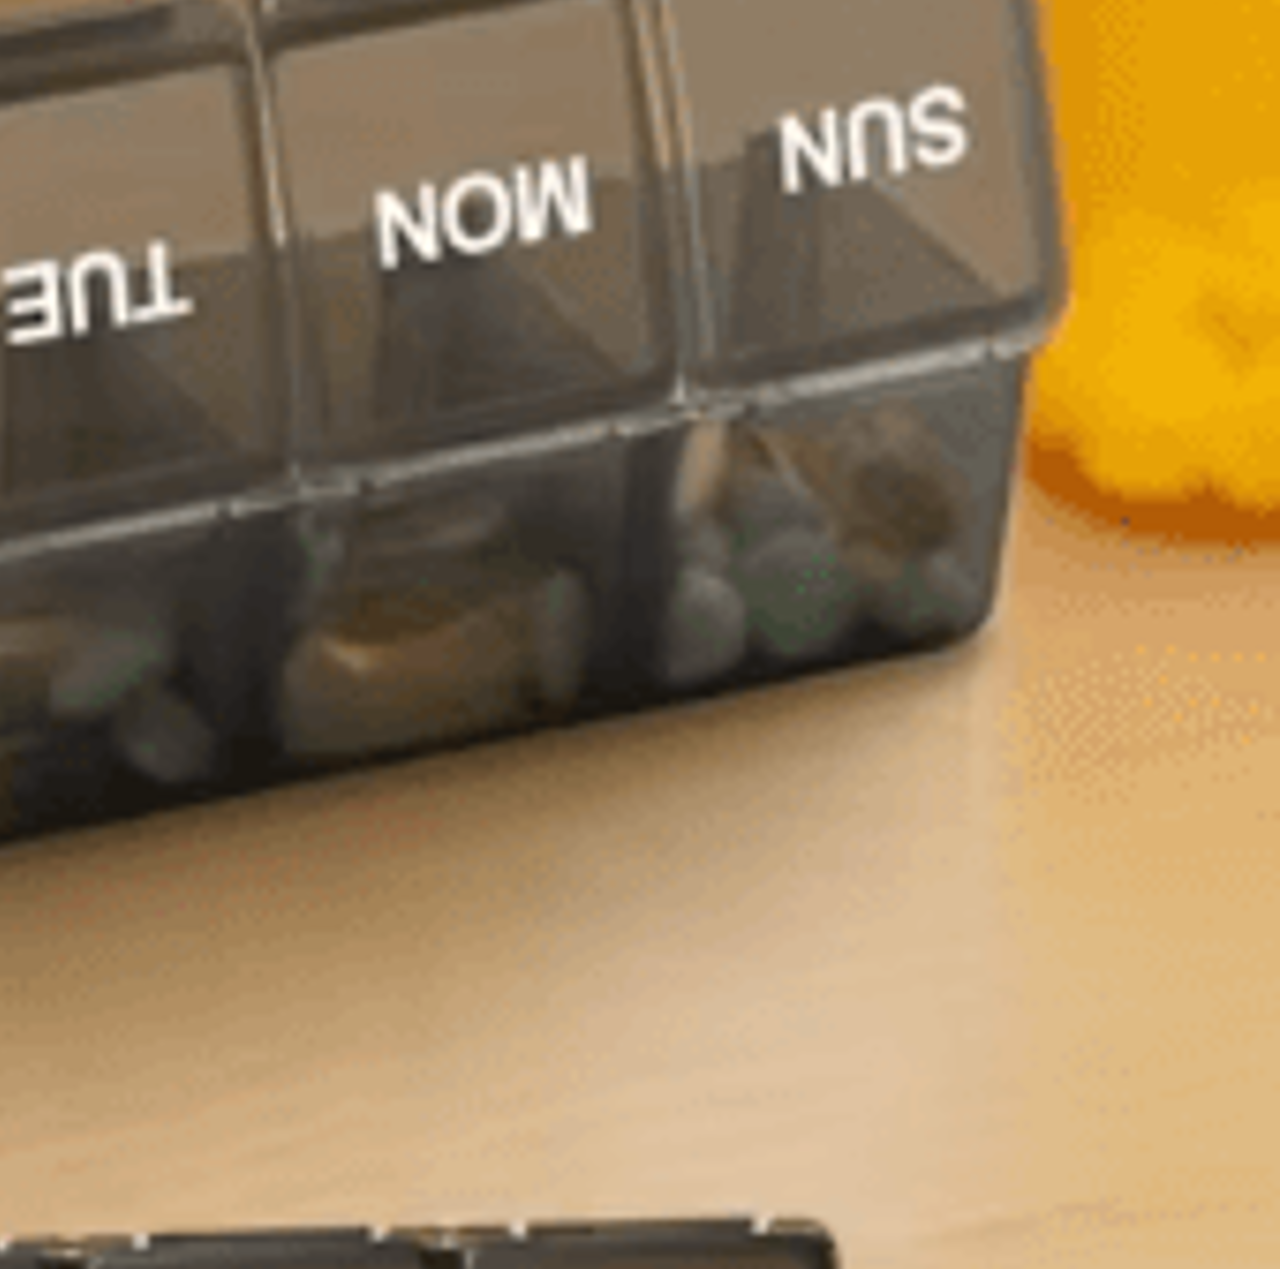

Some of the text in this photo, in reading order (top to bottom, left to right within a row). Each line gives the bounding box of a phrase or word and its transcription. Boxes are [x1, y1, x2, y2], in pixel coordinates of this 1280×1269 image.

[778, 83, 968, 193] SUN
[374, 154, 591, 268] MON
[1, 240, 191, 347] TUE
